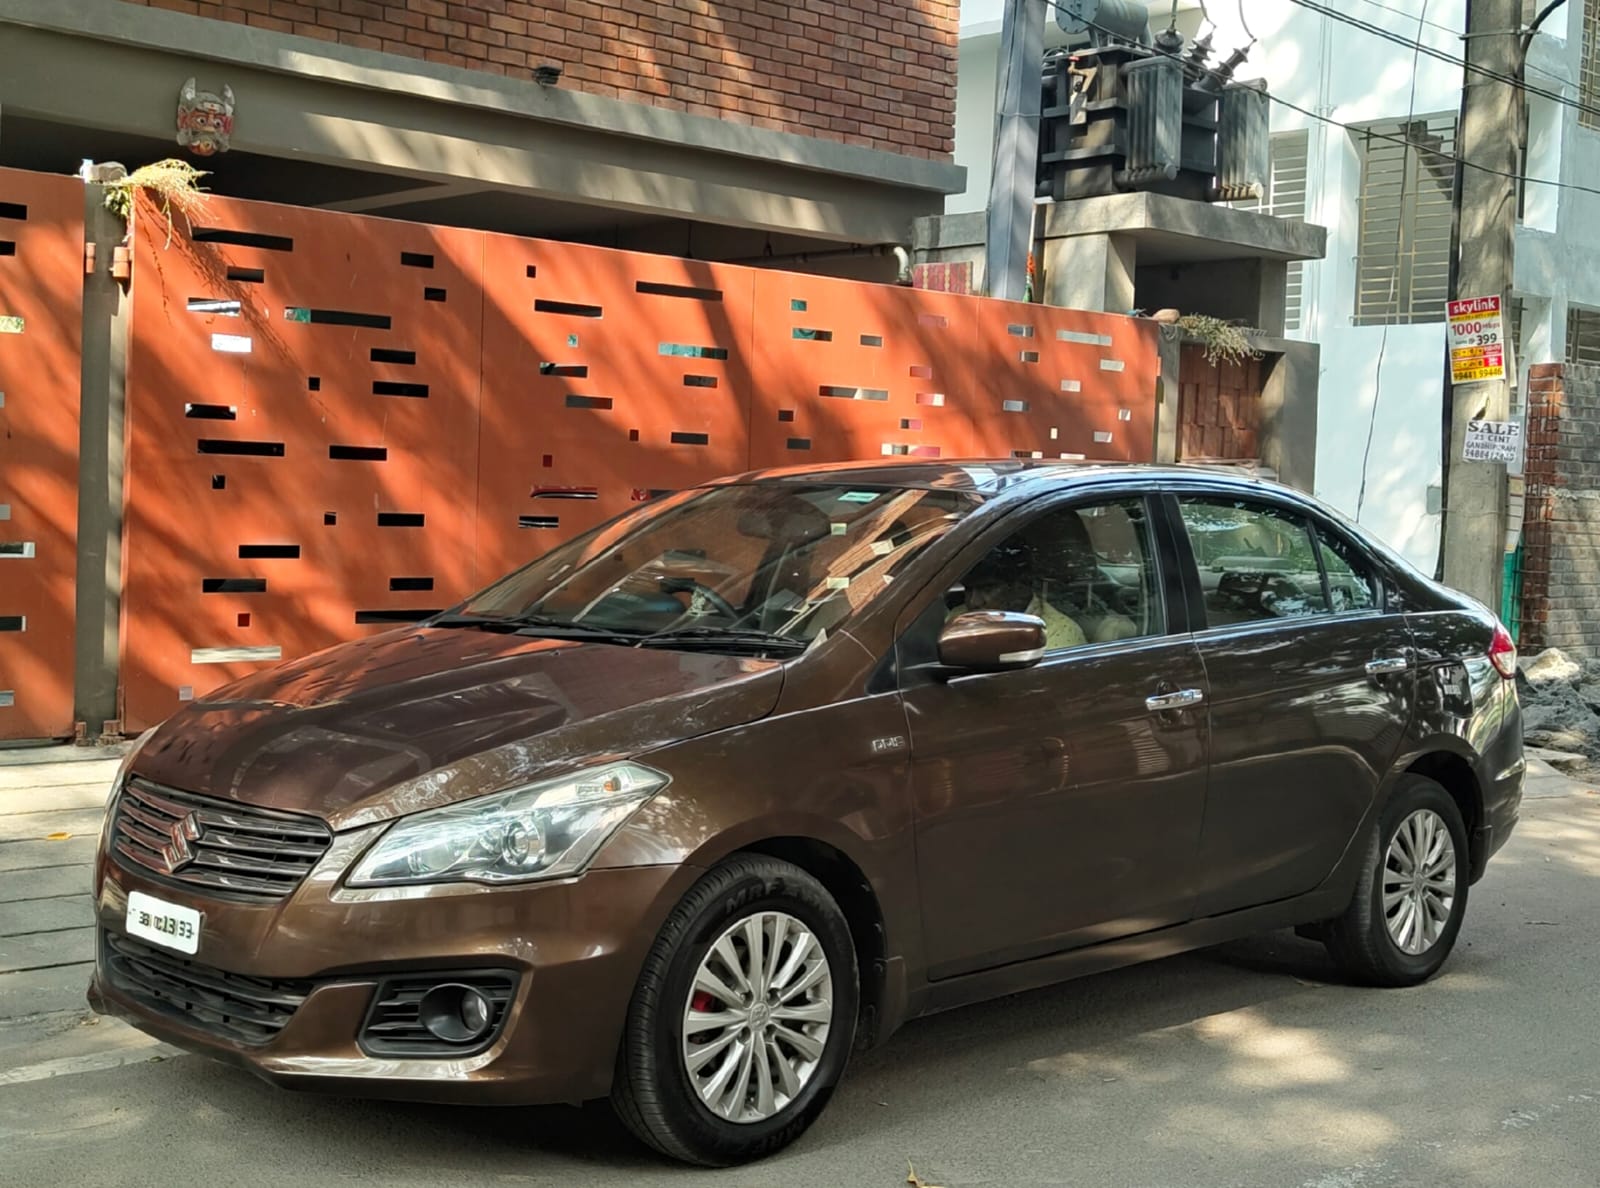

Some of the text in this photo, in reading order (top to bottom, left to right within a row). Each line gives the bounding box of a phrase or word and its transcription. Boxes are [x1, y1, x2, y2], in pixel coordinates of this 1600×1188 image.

[1453, 299, 1496, 314] skylink
[1452, 322, 1482, 336] 1000
[1476, 333, 1497, 345] 399
[1468, 421, 1520, 436] SALE
[1488, 435, 1511, 443] CENT
